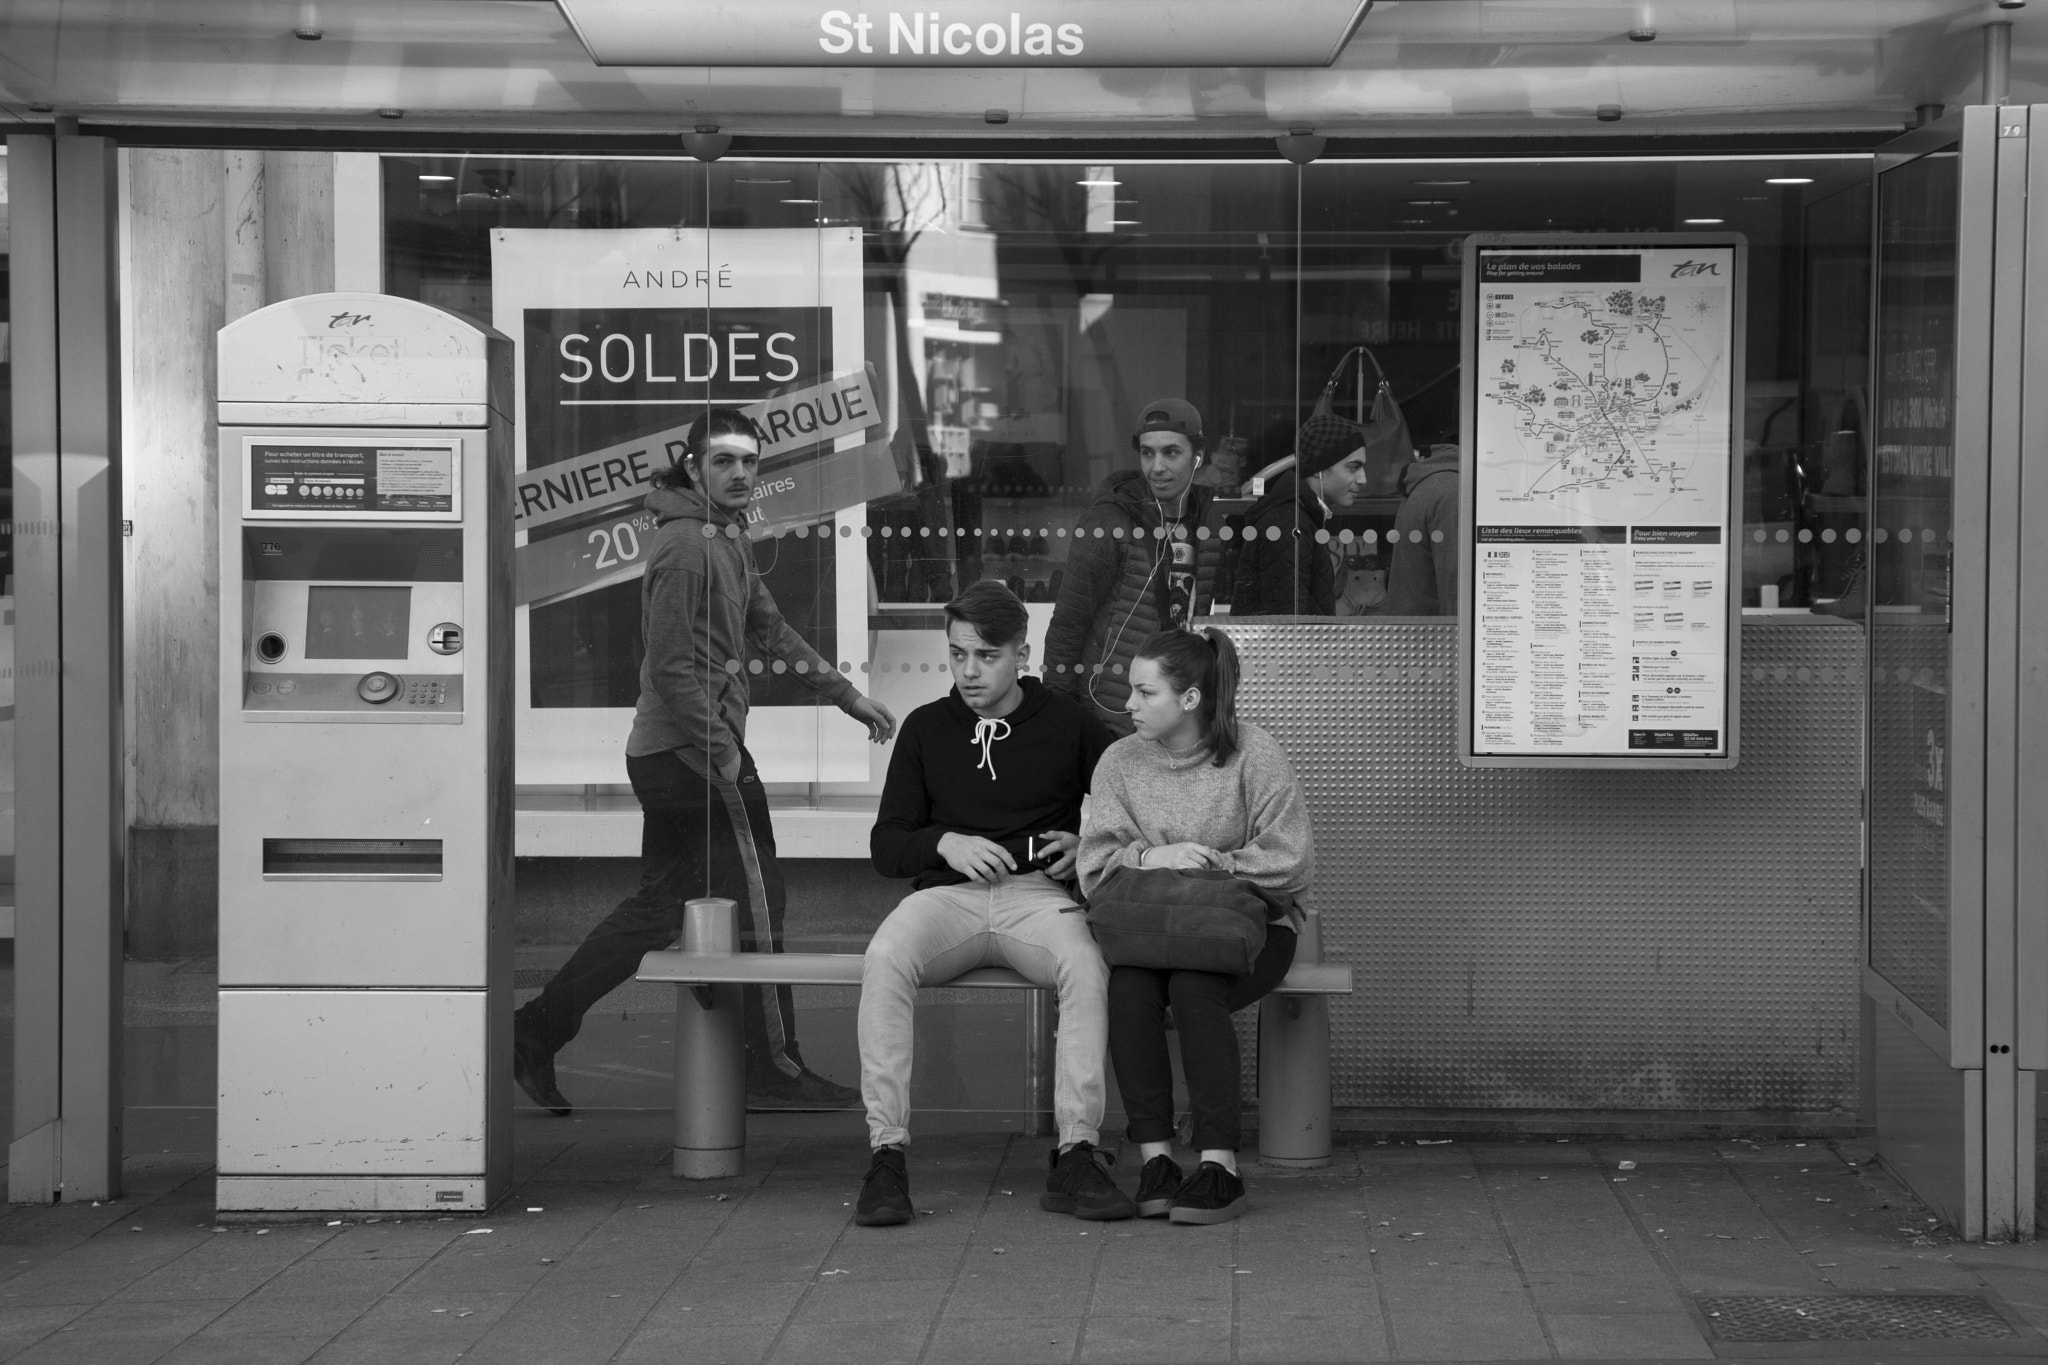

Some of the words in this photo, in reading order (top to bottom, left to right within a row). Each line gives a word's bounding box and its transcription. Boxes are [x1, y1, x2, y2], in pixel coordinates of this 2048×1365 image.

[819, 10, 873, 54] St
[889, 12, 1085, 56] Nicolas
[1486, 262, 1496, 271] Le
[1498, 262, 1517, 272] plan
[1518, 262, 1529, 271] de
[1530, 263, 1546, 271] vos
[1547, 261, 1582, 271] balades
[622, 263, 733, 289] ANDRÉ
[560, 332, 799, 383] SOLDES
[265, 451, 279, 459] Pour
[279, 451, 303, 459] acheter
[311, 451, 326, 460] titre
[326, 452, 334, 460] de
[515, 448, 651, 521] RNIERE
[664, 385, 868, 467] DARQUE
[1481, 527, 1499, 535] Liste
[1500, 527, 1513, 535] des
[1514, 527, 1532, 535] lieux
[1532, 527, 1583, 537] remarquables
[1634, 529, 1651, 537] Pour
[1651, 529, 1668, 537] bien
[1668, 530, 1699, 539] voyager
[262, 542, 281, 551] 776
